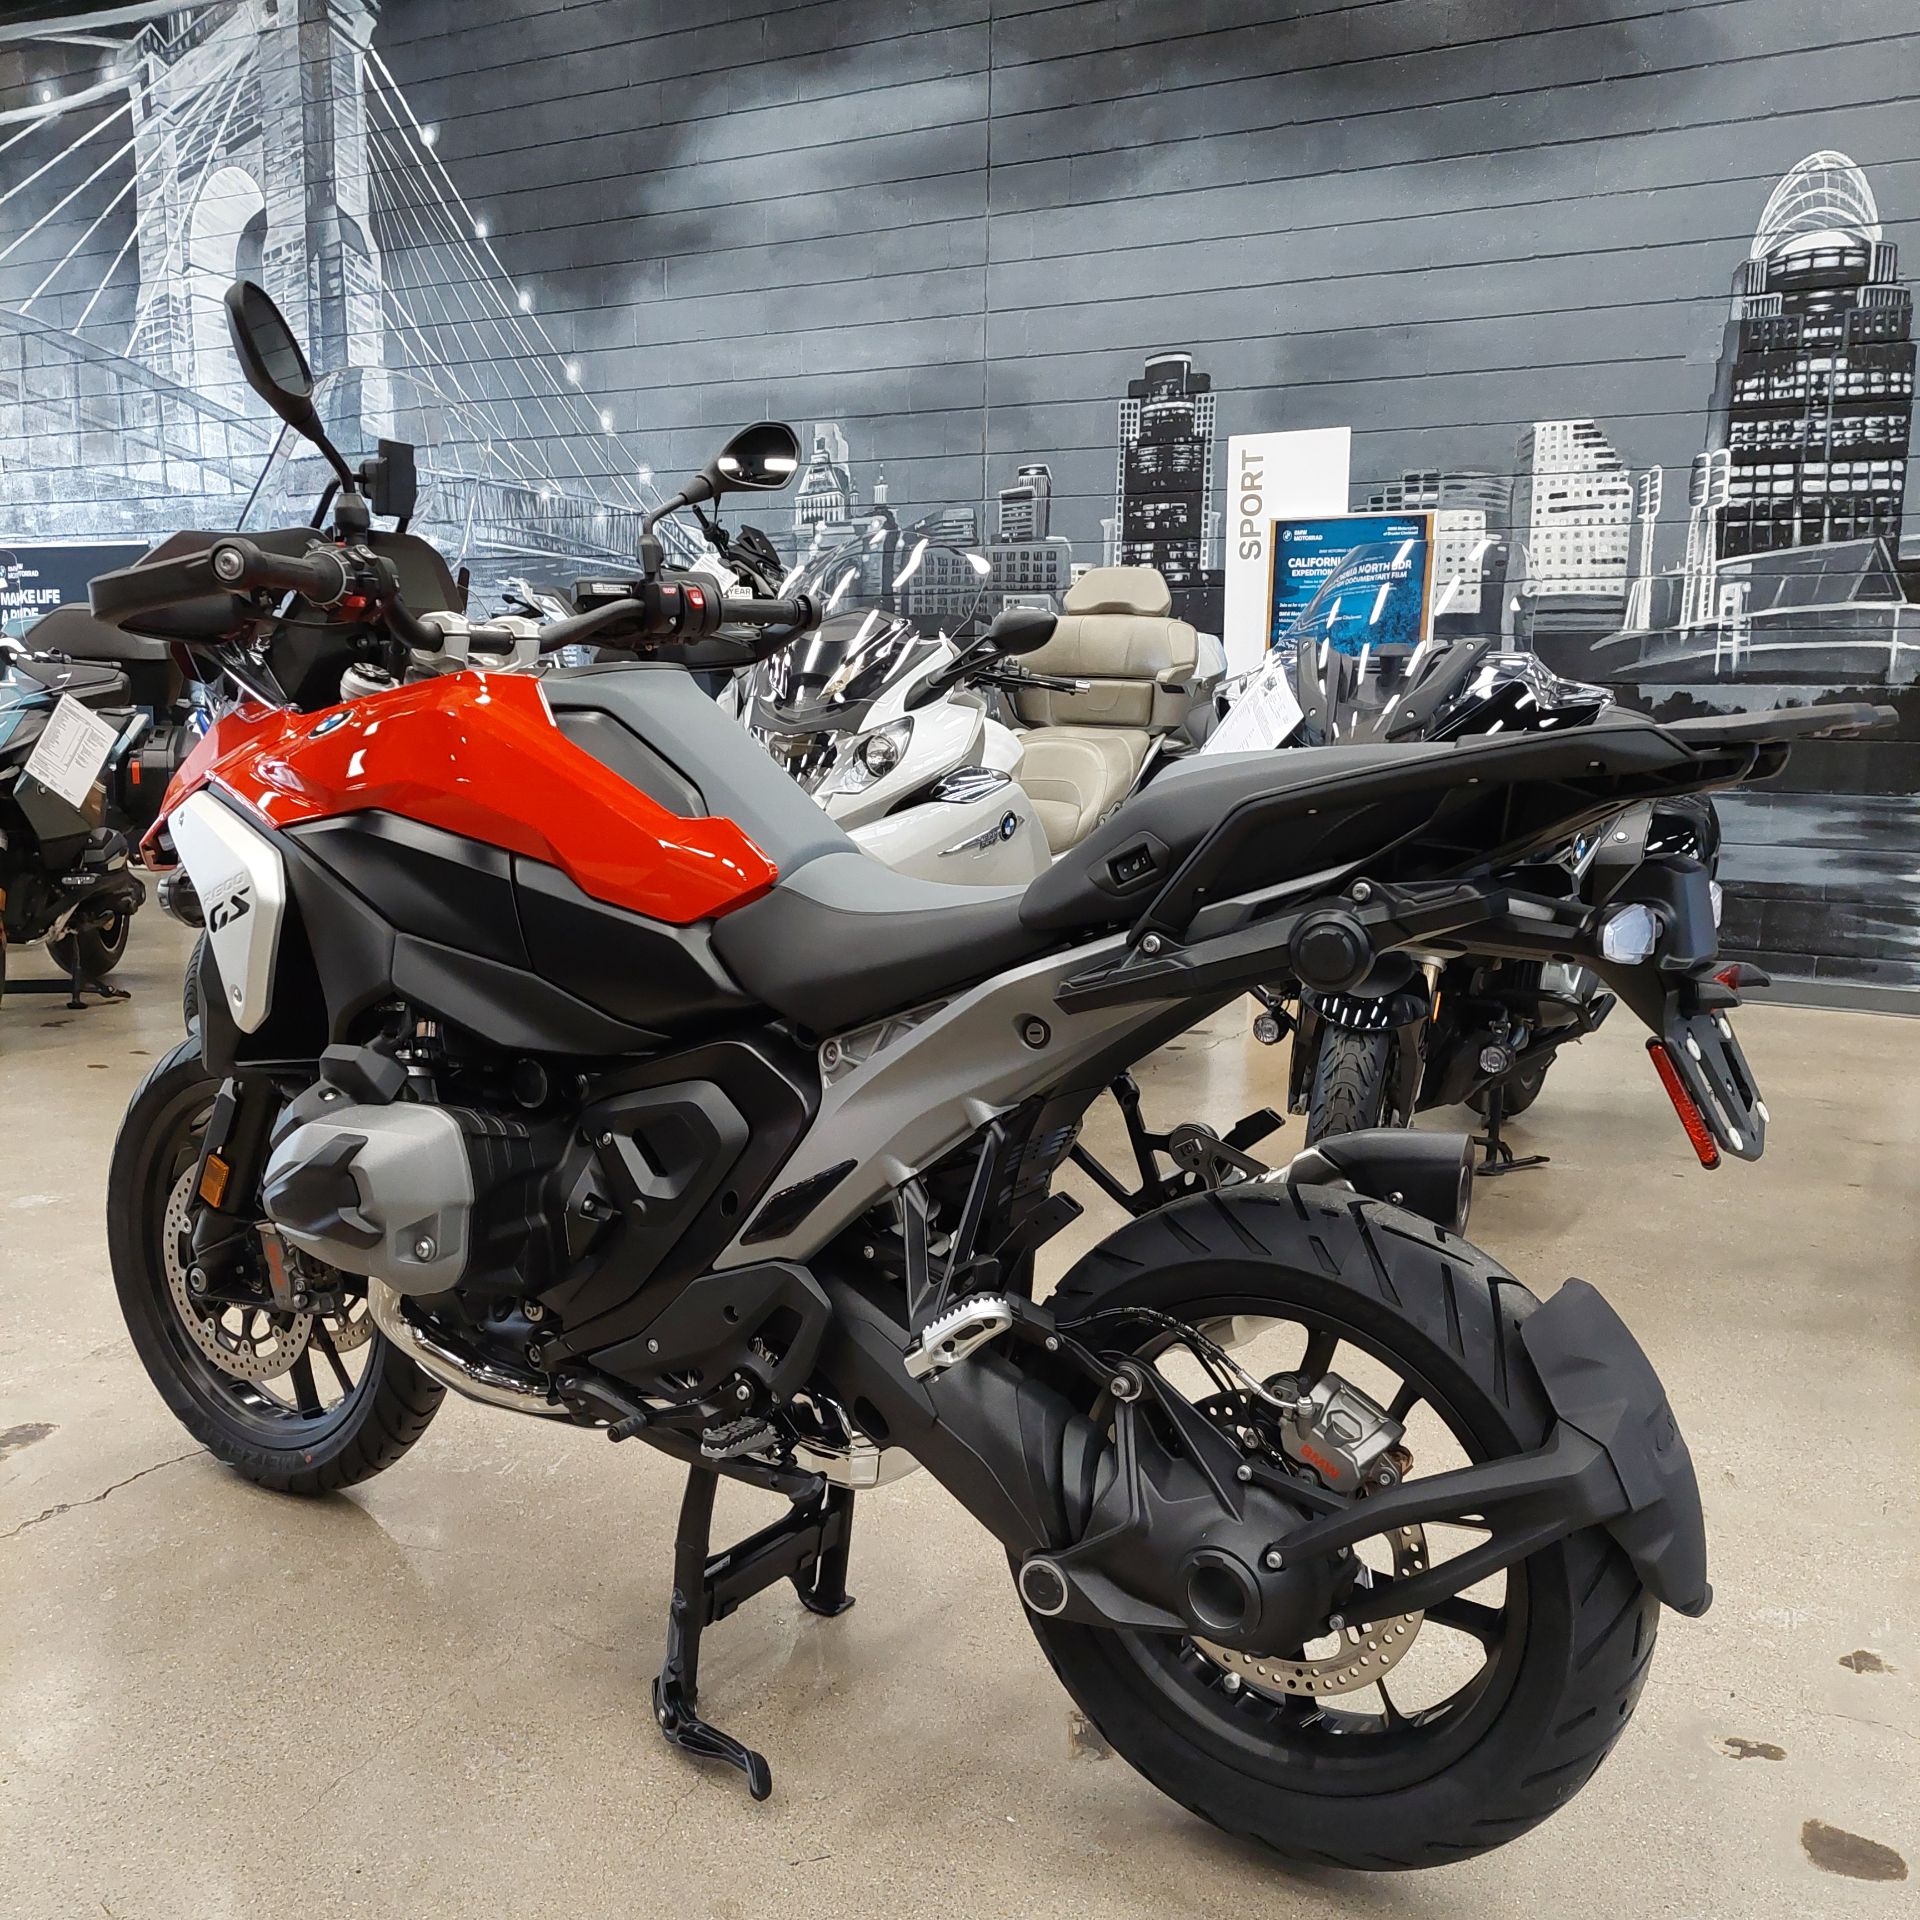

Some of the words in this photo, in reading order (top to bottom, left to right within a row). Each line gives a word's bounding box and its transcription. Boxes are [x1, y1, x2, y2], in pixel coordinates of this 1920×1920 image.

[1239, 449, 1264, 560] SPORT
[1358, 562, 1390, 574] NORTH
[1391, 571, 1408, 579] FILM
[36, 589, 61, 604] LIFE
[729, 587, 751, 596] YEAR
[210, 885, 250, 933] GS
[1300, 1443, 1341, 1480] BMW
